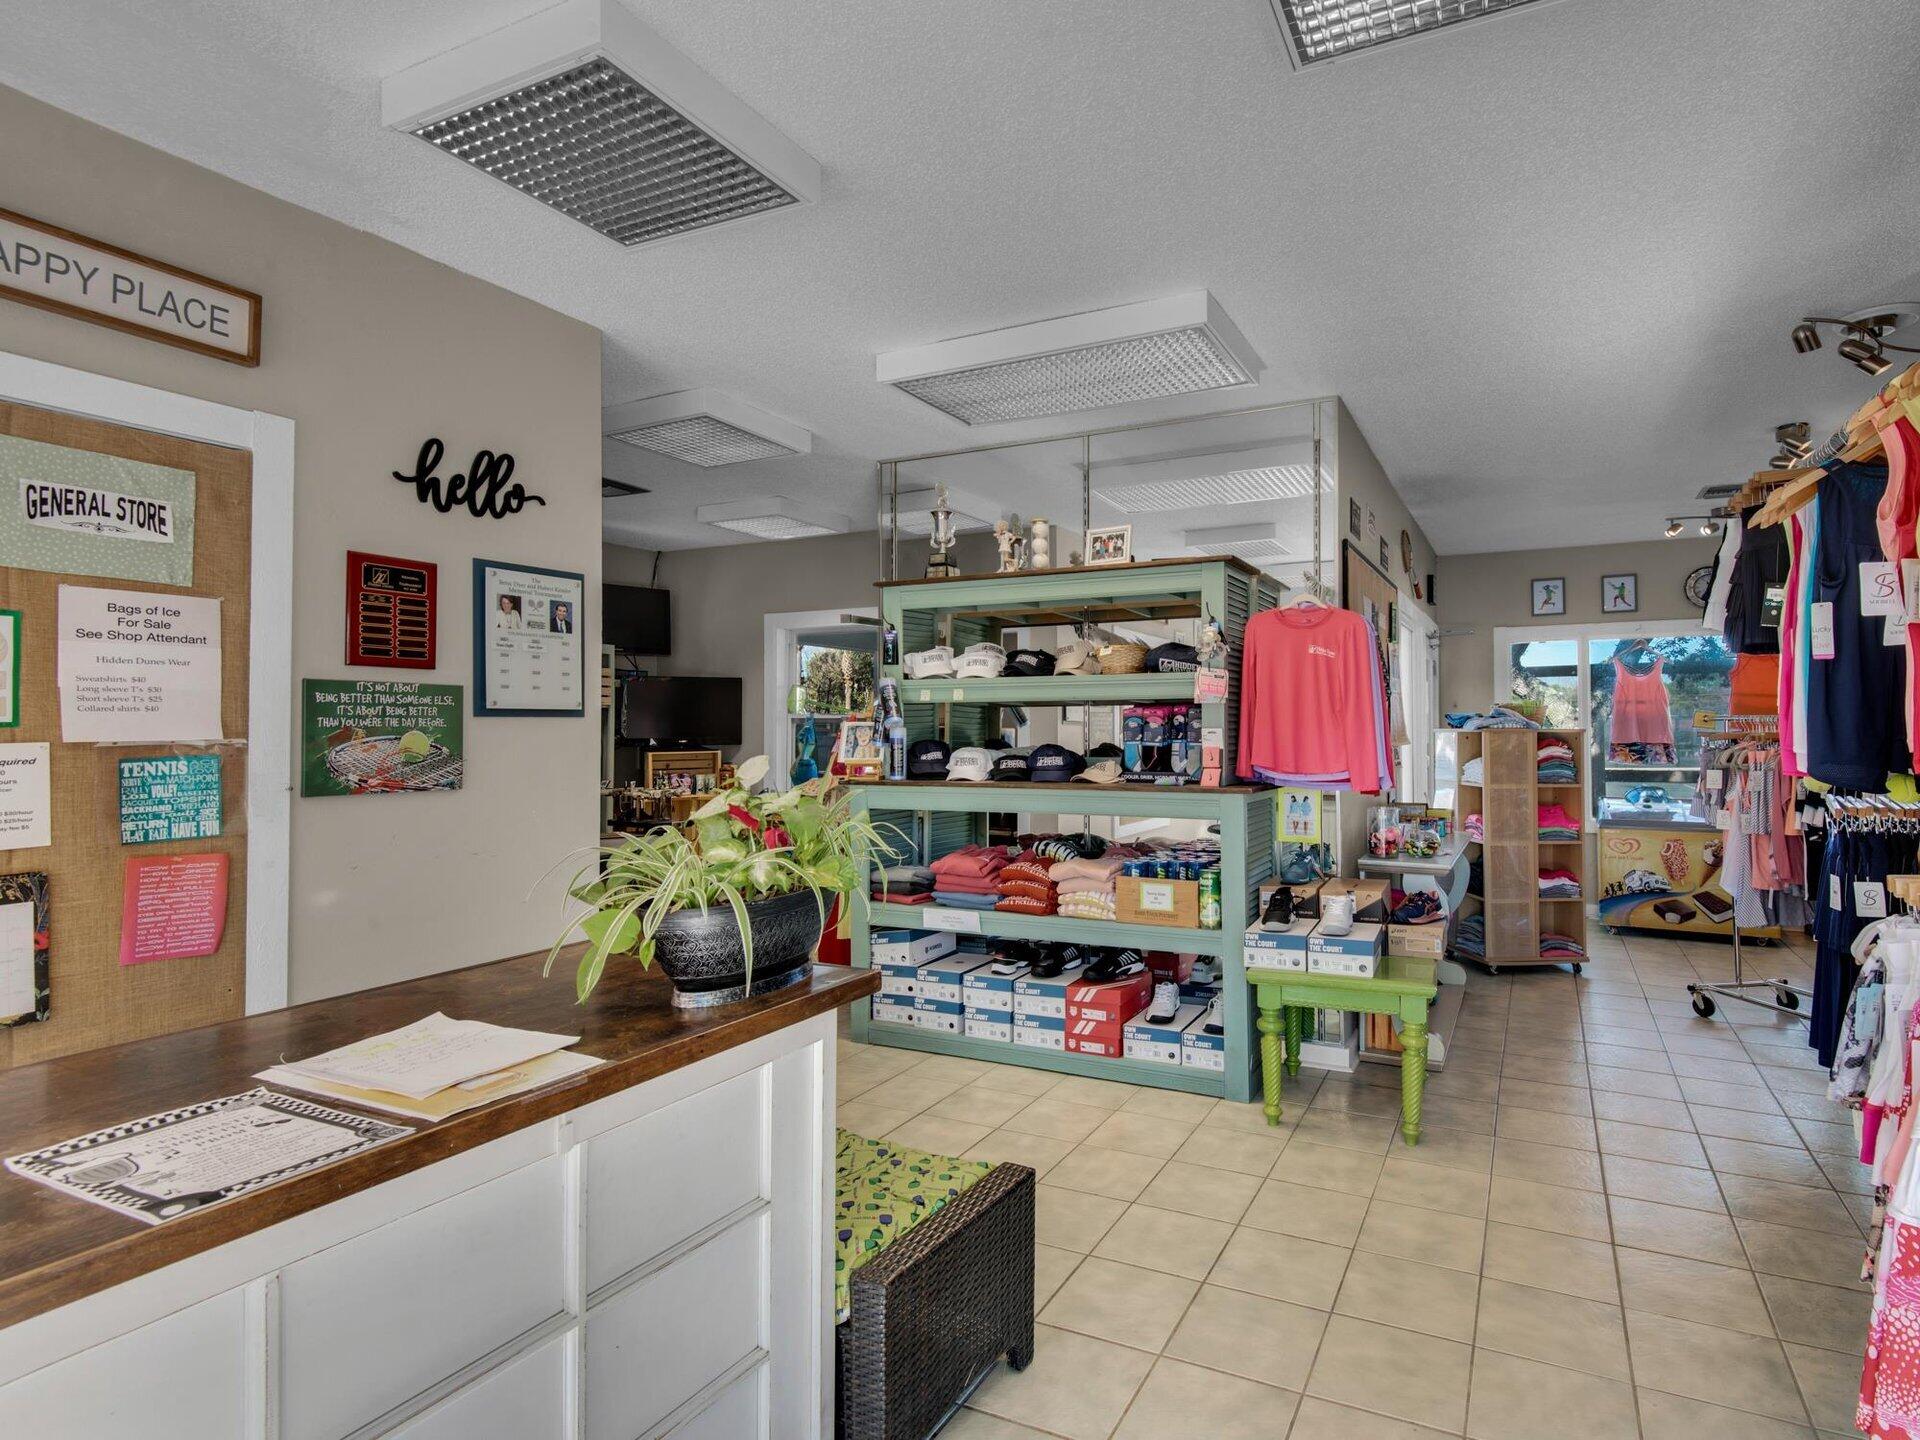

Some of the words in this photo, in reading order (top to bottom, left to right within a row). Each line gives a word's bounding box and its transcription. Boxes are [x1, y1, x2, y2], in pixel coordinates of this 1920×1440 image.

[112, 273, 229, 337] PLACE
[392, 438, 546, 519] hello
[26, 484, 111, 520] GENERAL
[116, 496, 169, 536] STORE
[107, 603, 141, 616] Bags
[145, 606, 158, 615] of
[163, 607, 181, 617] Ice
[117, 617, 140, 627] For
[144, 619, 172, 630] Sale
[76, 629, 103, 639] See
[107, 630, 143, 643] Shop
[146, 633, 207, 645] Attendant
[96, 656, 133, 664] Hidden
[136, 657, 165, 666] Dunes
[168, 659, 191, 667] Wear
[76, 675, 127, 683] Sweatshirts
[76, 685, 100, 694] Long
[356, 682, 373, 691] IT'S
[375, 682, 389, 691] NOT
[393, 683, 419, 692] ABOUT
[315, 692, 338, 702] BEING
[340, 693, 372, 703] BETTER
[374, 694, 395, 703] THAN
[396, 694, 432, 704] SOMEONE
[336, 706, 354, 715] IT'S
[355, 706, 383, 716] ABOUT
[385, 706, 407, 716] BEING
[408, 707, 437, 716] BETTER
[317, 717, 339, 727] THAN
[341, 717, 358, 727] YOU
[359, 717, 383, 727] WERE
[384, 717, 399, 727] THE
[401, 718, 416, 728] DAY
[121, 761, 188, 777] TENNIS
[171, 822, 197, 838] HAVE
[1258, 940, 1277, 948] COURT
[1135, 1033, 1152, 1041] COURT
